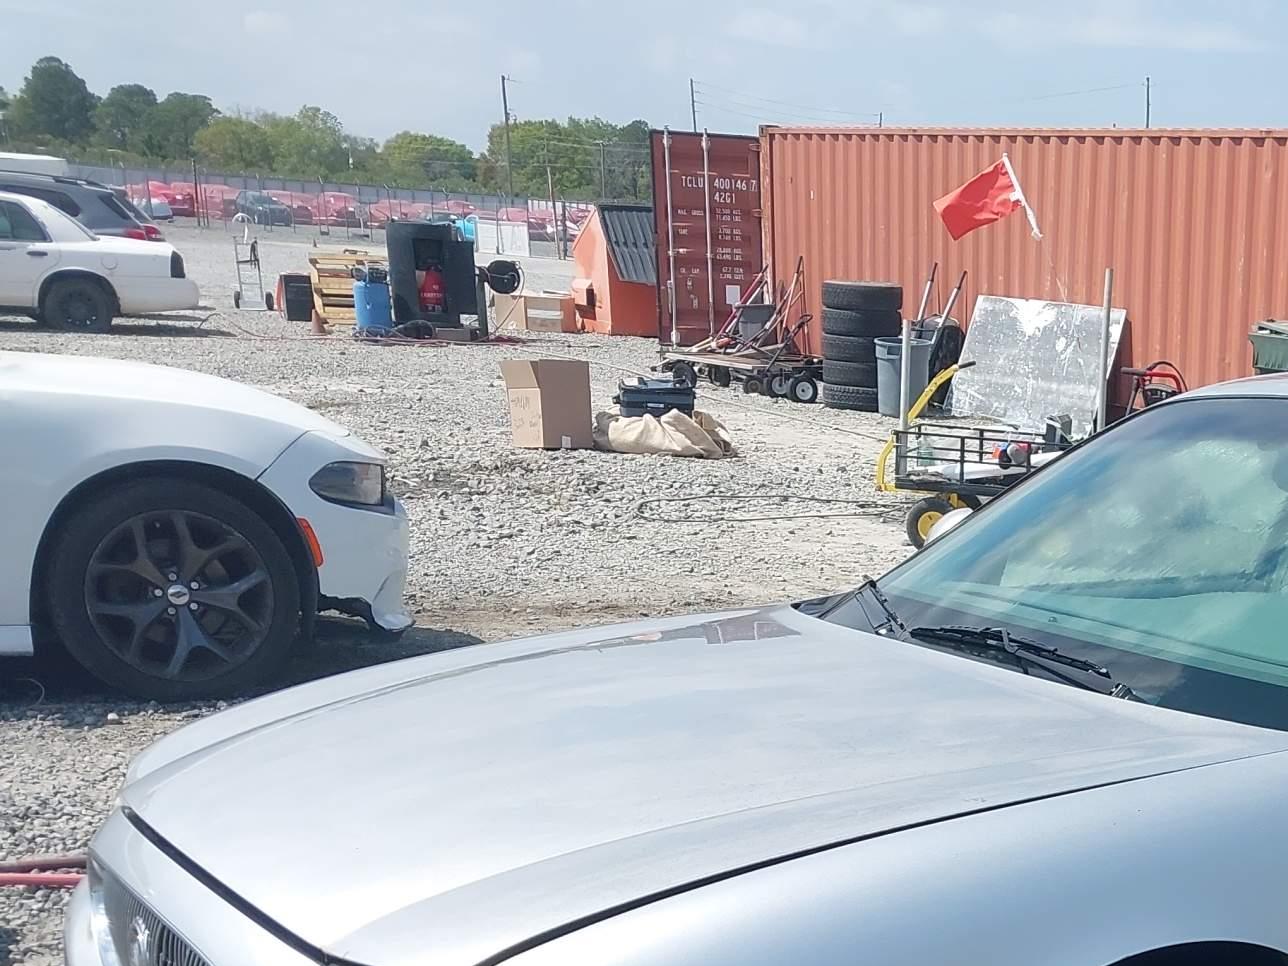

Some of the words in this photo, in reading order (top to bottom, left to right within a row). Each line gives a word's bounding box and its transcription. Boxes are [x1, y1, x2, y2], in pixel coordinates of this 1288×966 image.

[681, 175, 704, 188] TCLU
[713, 178, 747, 191] 400146
[714, 191, 736, 204] 42G1
